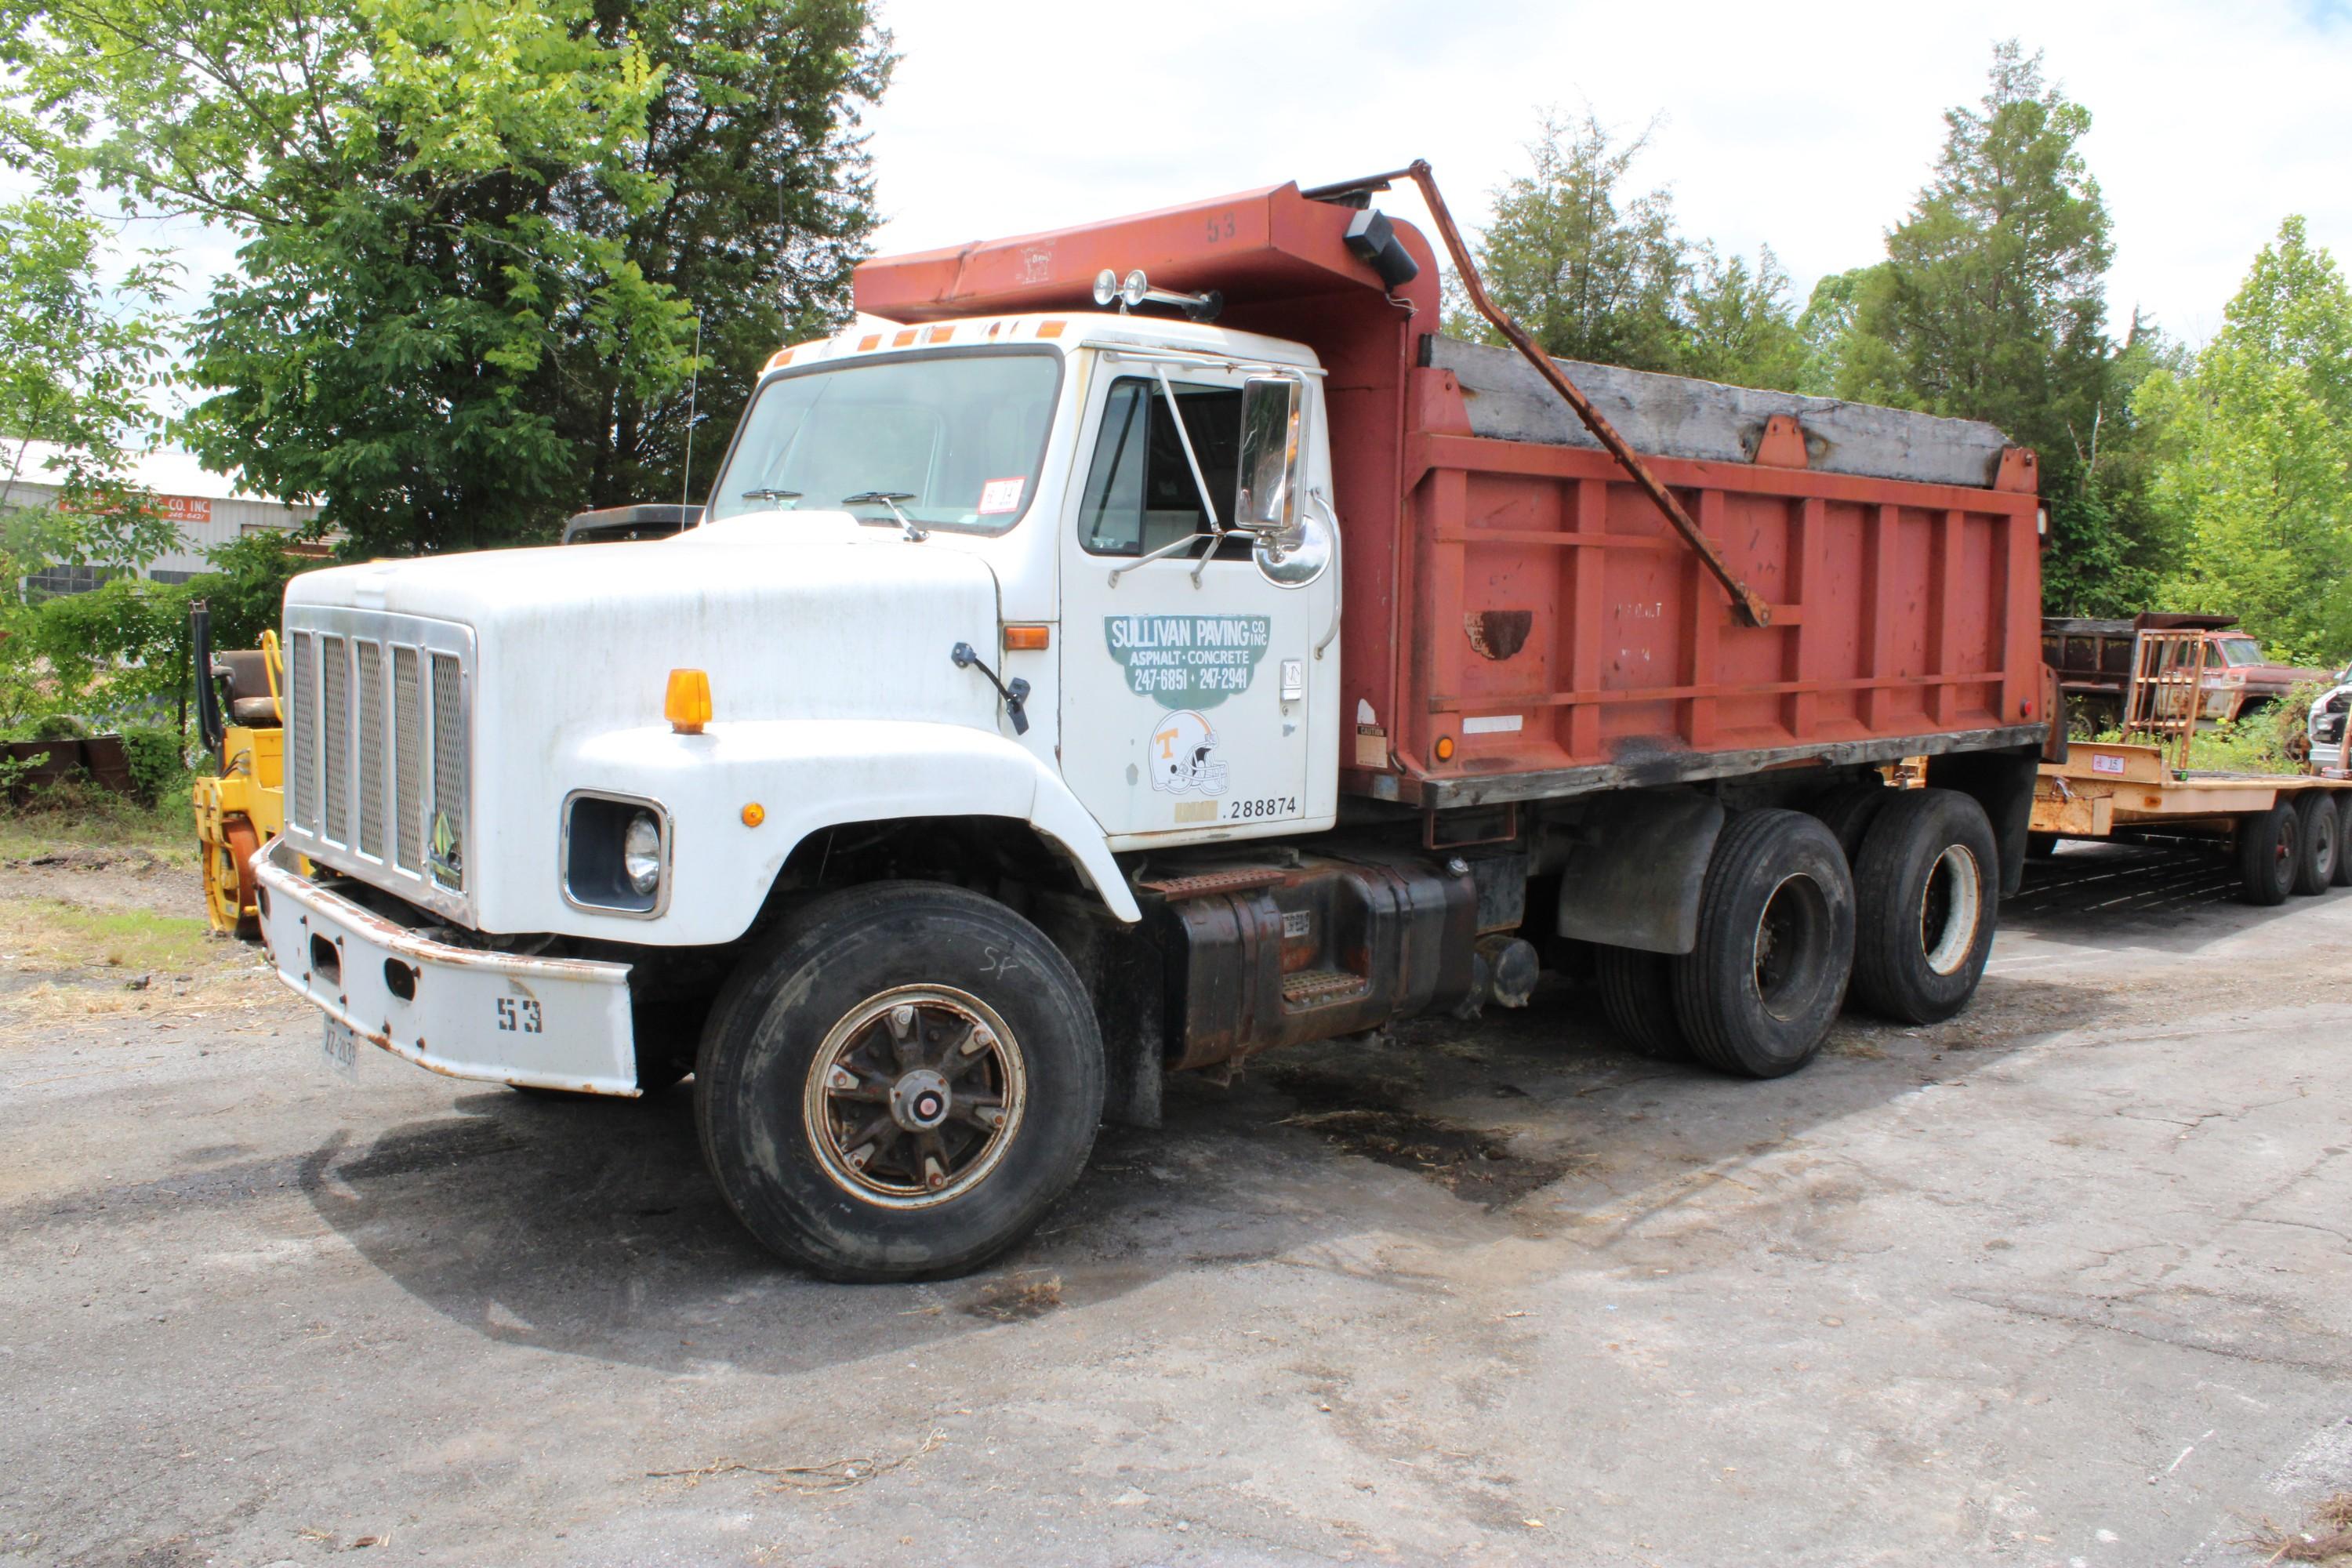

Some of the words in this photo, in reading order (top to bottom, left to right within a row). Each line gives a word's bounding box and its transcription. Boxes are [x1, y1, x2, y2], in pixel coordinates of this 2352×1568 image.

[1207, 212, 1236, 243] 53
[169, 499, 186, 511] CO.
[191, 500, 210, 513] INC.
[1112, 619, 1191, 648] SULLIVAN
[1196, 620, 1250, 647] PAVING
[1252, 621, 1265, 633] CO
[1250, 633, 1267, 646] INC
[1130, 651, 1181, 666] ASPHALT
[1188, 651, 1250, 665] CONCRETE
[1134, 669, 1188, 691] 247-6851
[1200, 667, 1247, 690] 247-2941
[1360, 727, 1385, 736] CAUTION
[1156, 728, 1178, 759] T
[497, 998, 543, 1033] 53
